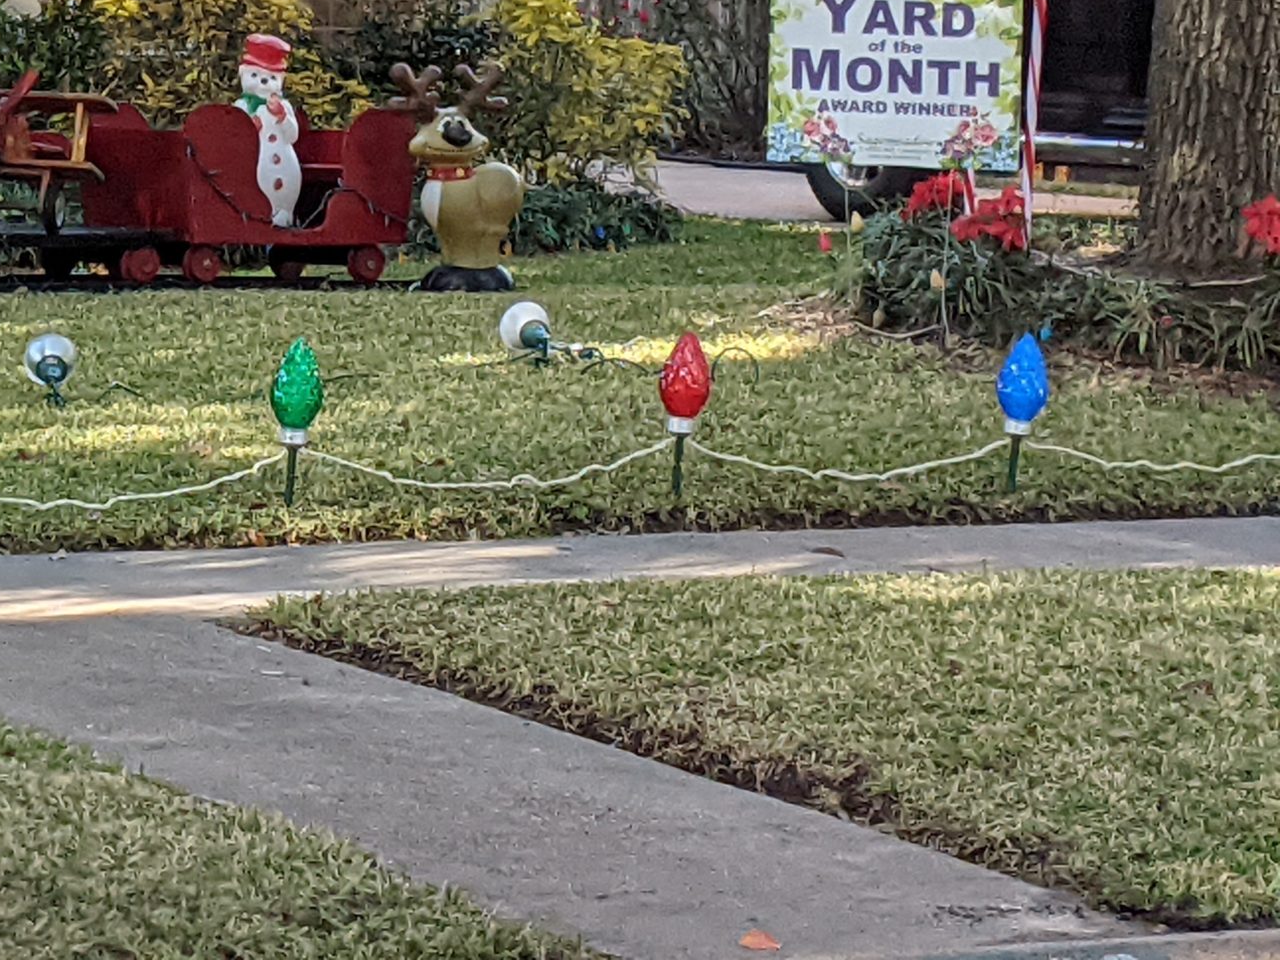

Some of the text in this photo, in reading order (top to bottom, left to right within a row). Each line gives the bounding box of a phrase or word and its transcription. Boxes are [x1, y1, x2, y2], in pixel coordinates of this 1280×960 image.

[868, 39, 923, 54] of the
[791, 48, 1000, 97] MONTH
[818, 98, 971, 117] AWARD WINNER
